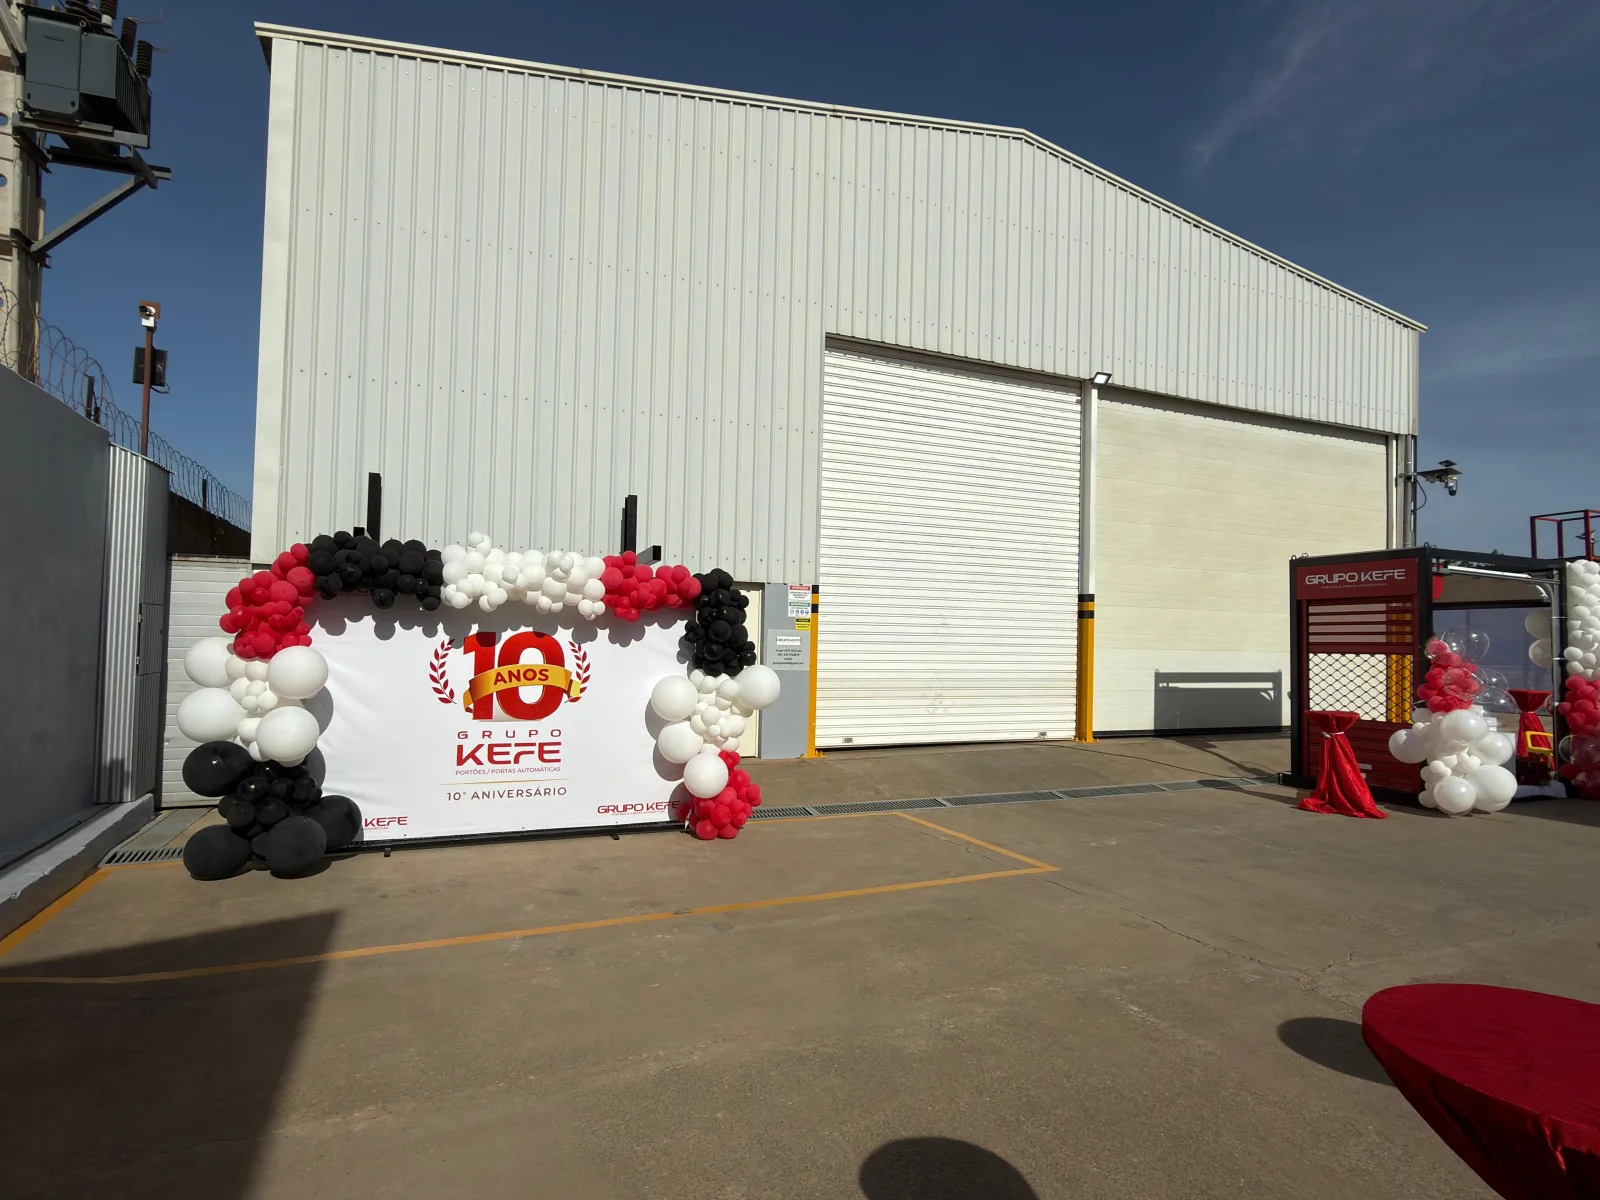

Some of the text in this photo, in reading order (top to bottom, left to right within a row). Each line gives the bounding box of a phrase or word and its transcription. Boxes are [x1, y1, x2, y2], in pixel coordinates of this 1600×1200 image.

[1305, 568, 1406, 585] GRUPO KEFE
[463, 631, 565, 720] 10
[493, 668, 549, 686] ANOS
[457, 728, 562, 740] GRUPO
[456, 741, 562, 766] KEFE
[471, 786, 567, 800] ANIVERSÁRIO
[597, 803, 645, 814] GRUPO
[646, 800, 681, 811] KEFE
[364, 816, 408, 827] KEFE
